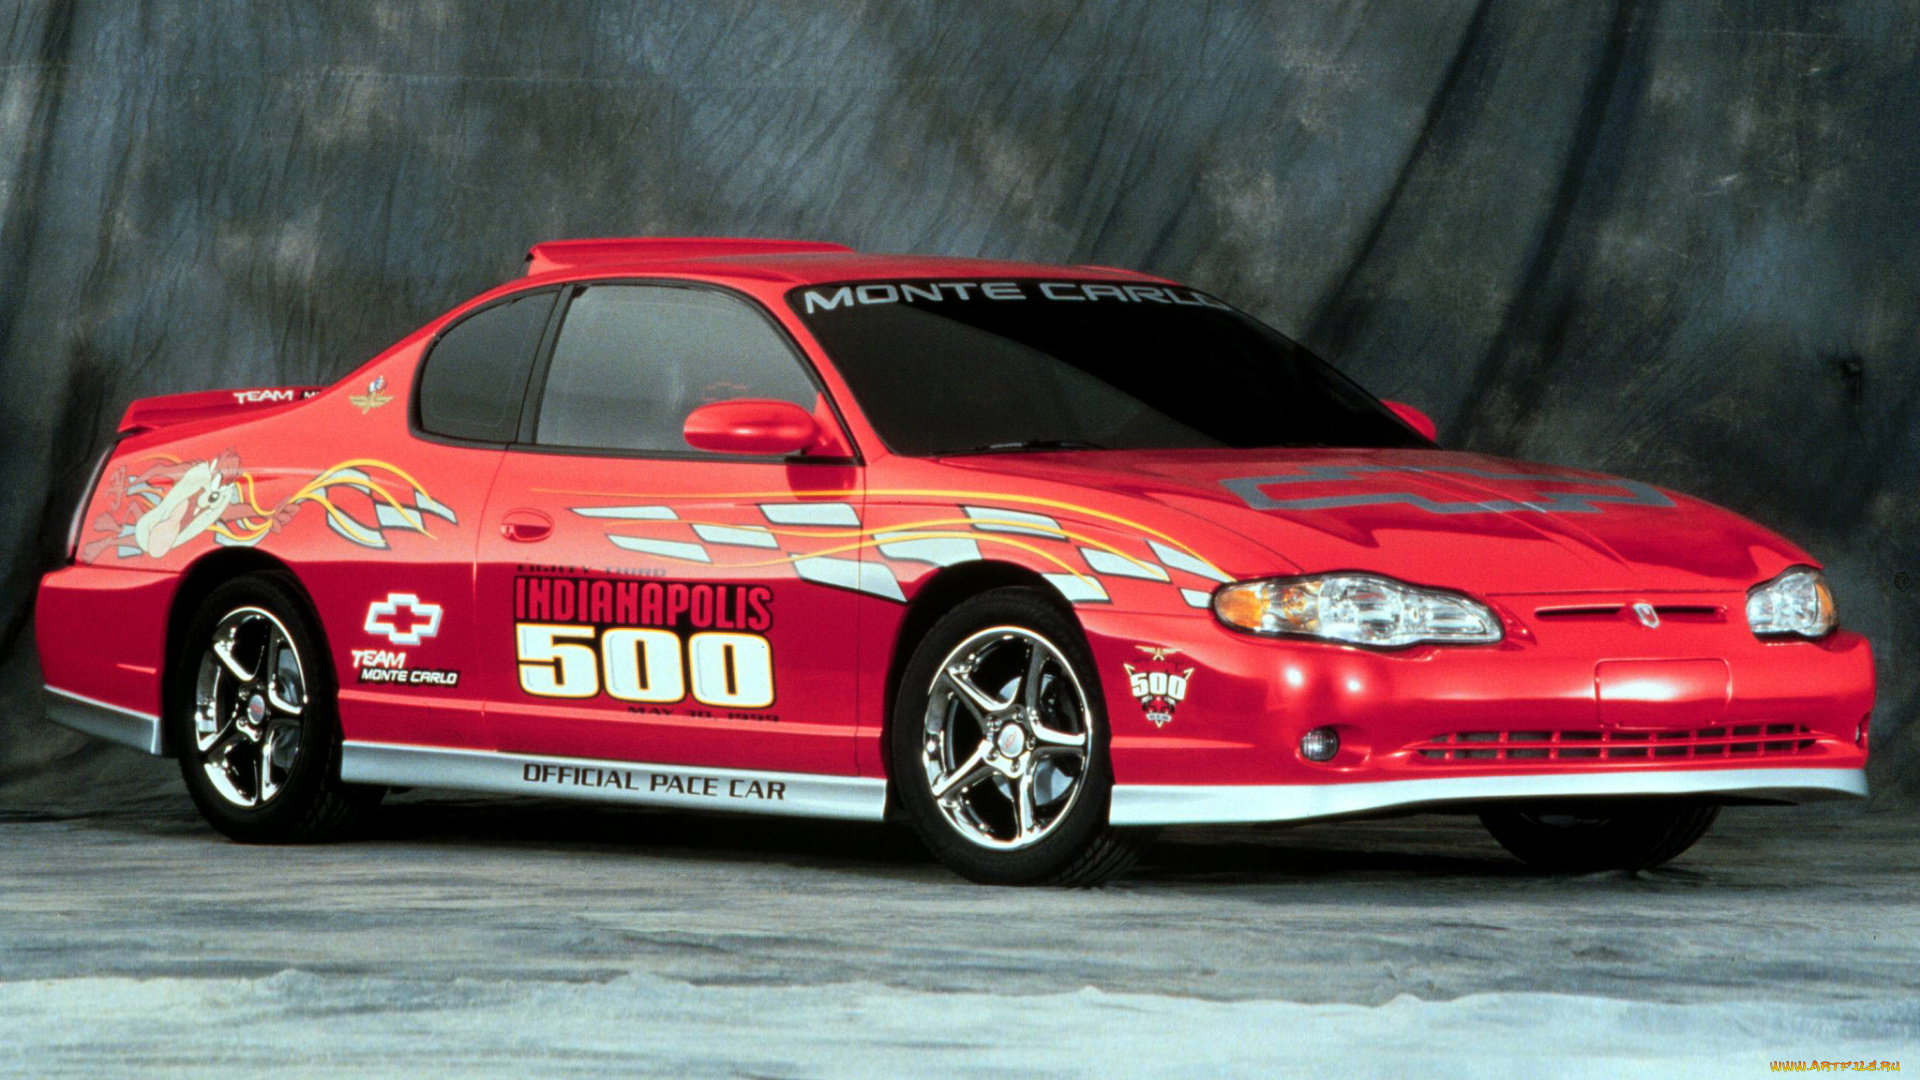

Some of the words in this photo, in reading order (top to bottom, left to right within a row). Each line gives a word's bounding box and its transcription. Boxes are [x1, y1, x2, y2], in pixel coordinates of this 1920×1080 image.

[805, 281, 1026, 314] MONTE
[233, 390, 294, 404] TEAM
[515, 576, 773, 632] INDIANAPOLIS
[351, 649, 406, 669] TEAM
[515, 622, 775, 709] 500
[361, 668, 408, 682] MONTE
[410, 670, 458, 685] CARLO
[1130, 672, 1187, 700] 500
[627, 706, 674, 716] MAY
[727, 712, 780, 723] 1999
[523, 763, 639, 791] OFFICIAL
[650, 773, 719, 797] PACE
[729, 778, 787, 800] CAR
